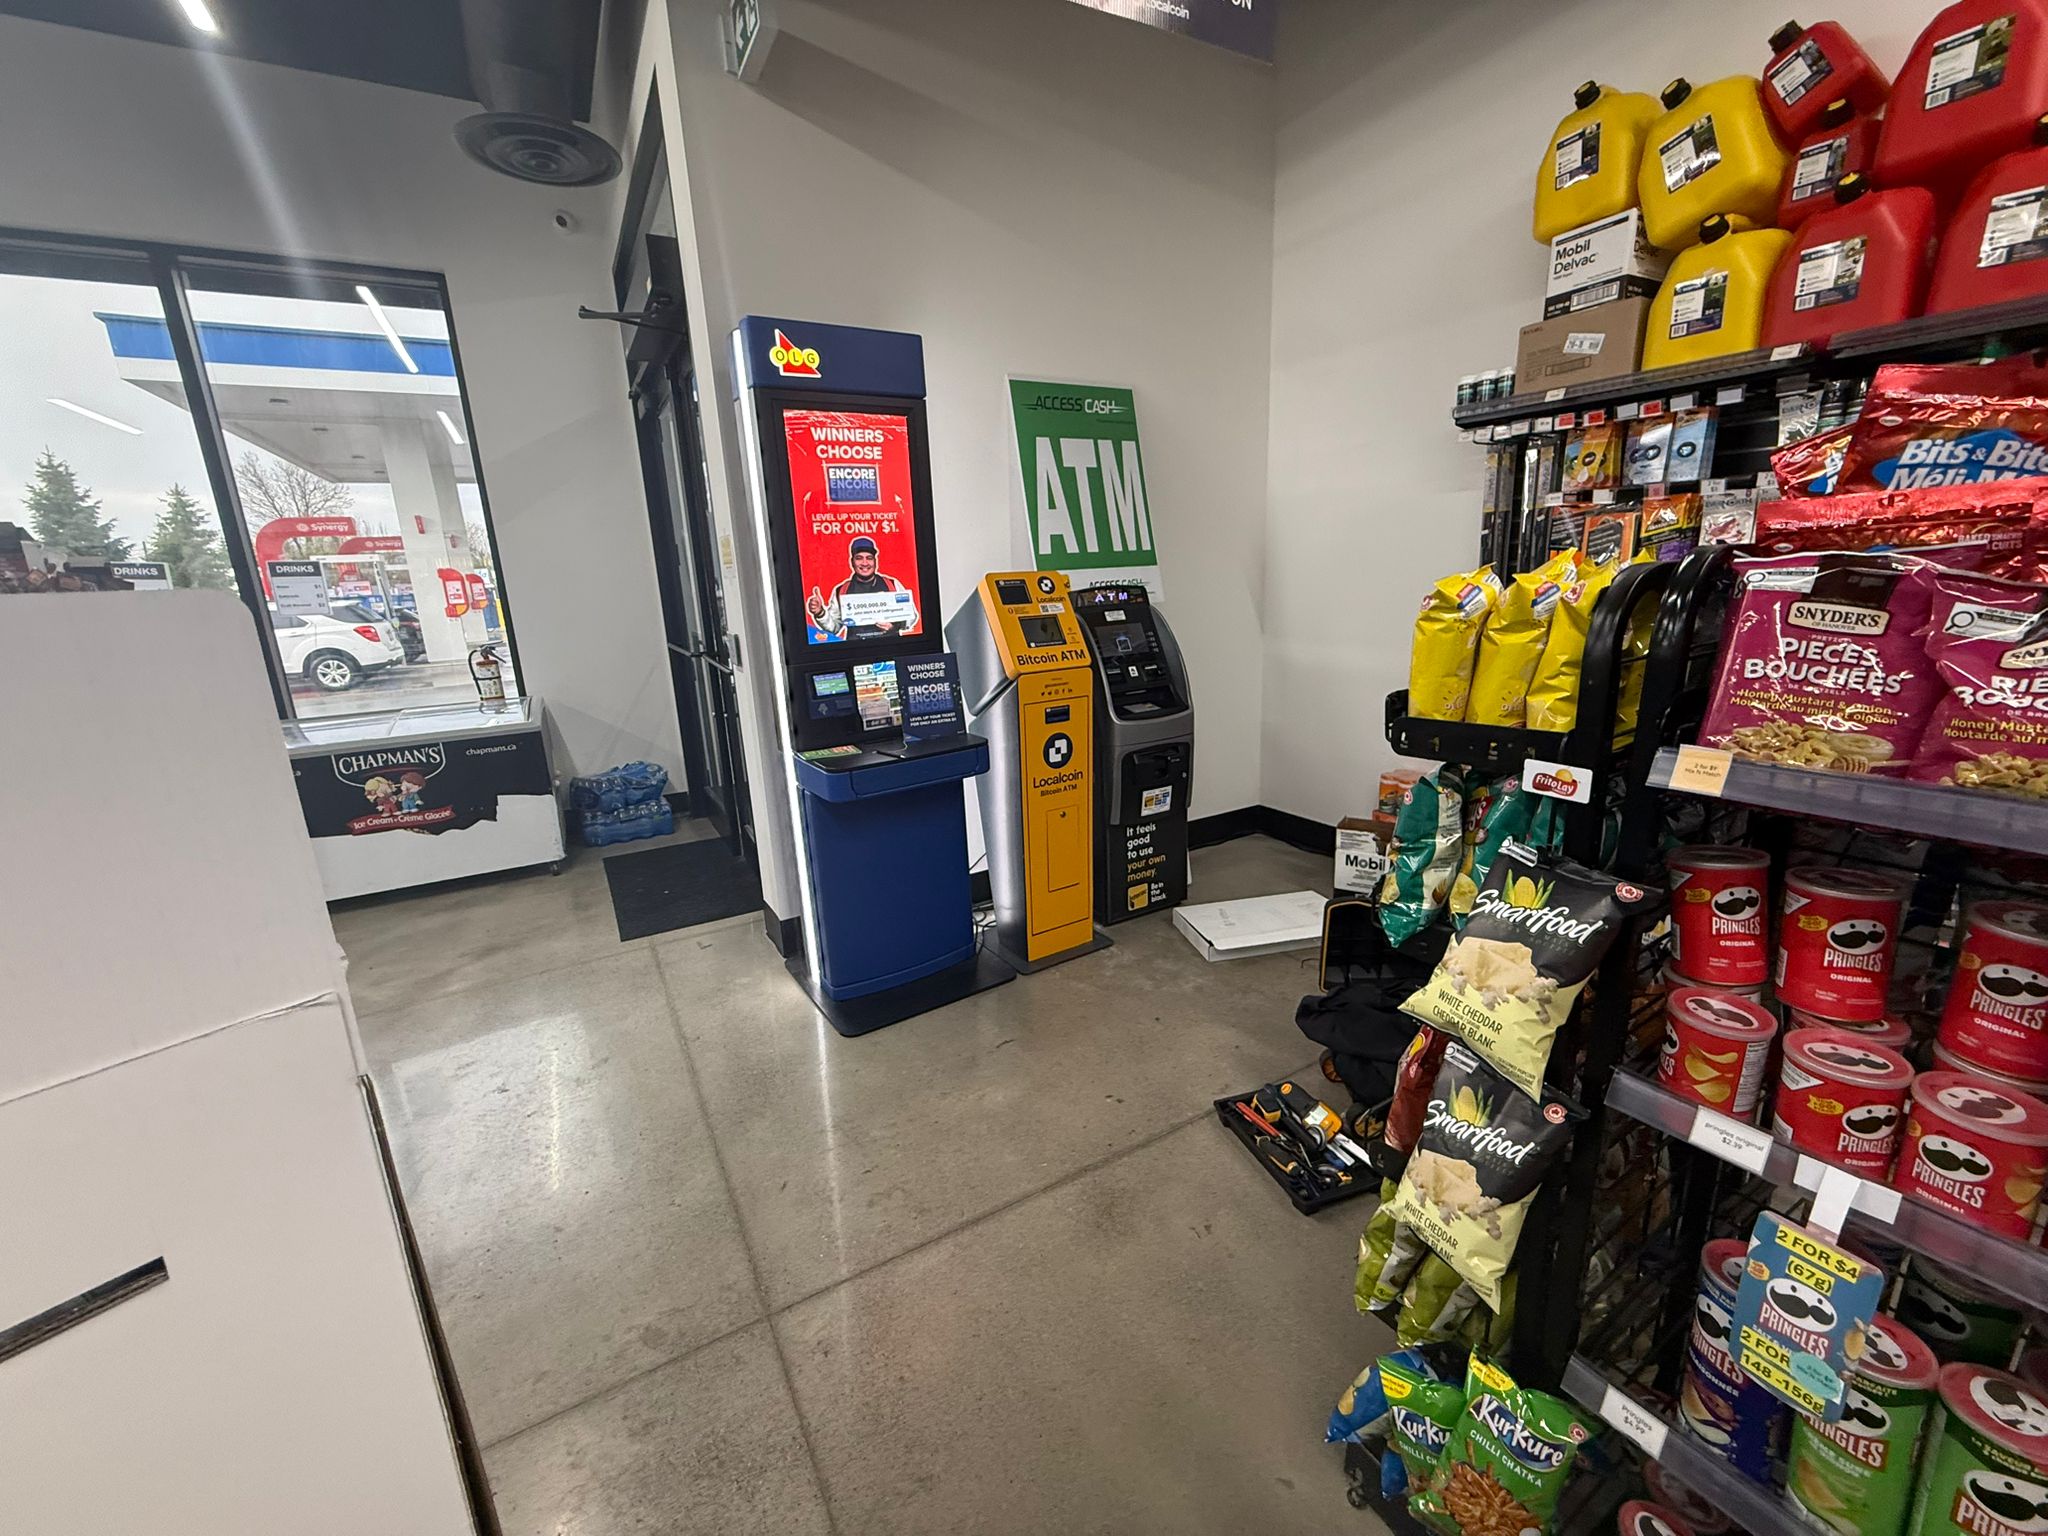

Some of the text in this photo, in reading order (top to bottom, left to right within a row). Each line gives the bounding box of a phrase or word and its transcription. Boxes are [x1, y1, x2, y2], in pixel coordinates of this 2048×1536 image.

[1556, 239, 1591, 261] Mobil
[1554, 253, 1596, 275] Delvac
[774, 348, 816, 365] OLG
[1036, 396, 1115, 414] ACCESS CASH
[810, 427, 884, 443] WINNERS
[816, 445, 882, 460] CHOOSE
[1897, 439, 1973, 465] Bits
[1971, 447, 1987, 461] &
[829, 468, 875, 479] ENCORE
[830, 479, 876, 489] ENCORE
[1036, 436, 1151, 555] ATM
[812, 513, 835, 521] LEVEL
[872, 512, 897, 520] TICKET
[310, 523, 348, 532] Synergy
[813, 521, 899, 534] FOR ONLY $1.
[114, 567, 158, 576] DRINKS
[276, 565, 314, 573] DRINKS
[1095, 591, 1128, 602] ATM
[1794, 605, 1881, 628] SNYDER'S
[1017, 649, 1086, 667] Bitcoin ATM
[1781, 637, 1879, 667] PIECES
[907, 662, 945, 672] WINNERS
[910, 670, 945, 680] CHOOSE
[1743, 659, 1902, 694] BOUCHÉES
[908, 683, 950, 695] ENCORE
[909, 691, 951, 703] ENCORE
[1740, 688, 1781, 701] Honey
[1783, 693, 1834, 707] Mustard
[1951, 718, 1995, 732] Honey
[1943, 727, 2008, 742] Moutarde
[2012, 734, 2032, 744] au
[465, 744, 517, 756] chapmans.ca
[338, 747, 441, 775] CHAPMAN'S
[1033, 769, 1083, 788] Localcoin
[1040, 784, 1078, 797] Bitcoin ATM
[353, 820, 366, 830] Ice
[366, 816, 393, 826] Cream
[398, 813, 424, 823] Crème
[1126, 822, 1157, 837] It feels
[1127, 834, 1150, 850] good
[1127, 846, 1154, 859] to use
[1127, 855, 1166, 872] your own
[1345, 855, 1386, 871] Mobil
[1127, 868, 1157, 882] money.
[1151, 893, 1166, 902] black
[1468, 889, 1603, 945] Smartfood
[1712, 916, 1760, 936] PRINGLES
[1823, 947, 1883, 972] PRINGLES
[1830, 973, 1872, 984] ORIGINAL
[1438, 989, 1463, 1011] WHITE
[1462, 1004, 1503, 1035] CHEDDAR
[1969, 989, 2046, 1030] PRINGLES
[1973, 1017, 2027, 1040] ORIGINAL
[1467, 1028, 1496, 1051] BLANC
[1423, 1100, 1535, 1165] Smartfood
[1837, 1132, 1895, 1154] PRINGLES
[1844, 1158, 1883, 1167] ORIGINAL
[1912, 1158, 1986, 1208] PRINGLES
[1404, 1199, 1424, 1223] WHITE
[1424, 1218, 1459, 1249] CHEDDAR
[1776, 1229, 1858, 1279] 2 FOR $4
[1787, 1260, 1832, 1293] (67g)
[1759, 1302, 1829, 1360] PRINGLES
[1740, 1330, 1790, 1365] 2 FOR
[1743, 1354, 1772, 1379] 148
[1478, 1392, 1565, 1466] Kurkure
[1399, 1440, 1424, 1459] CHILLI
[1470, 1430, 1542, 1488] CHILLI CHATKA
